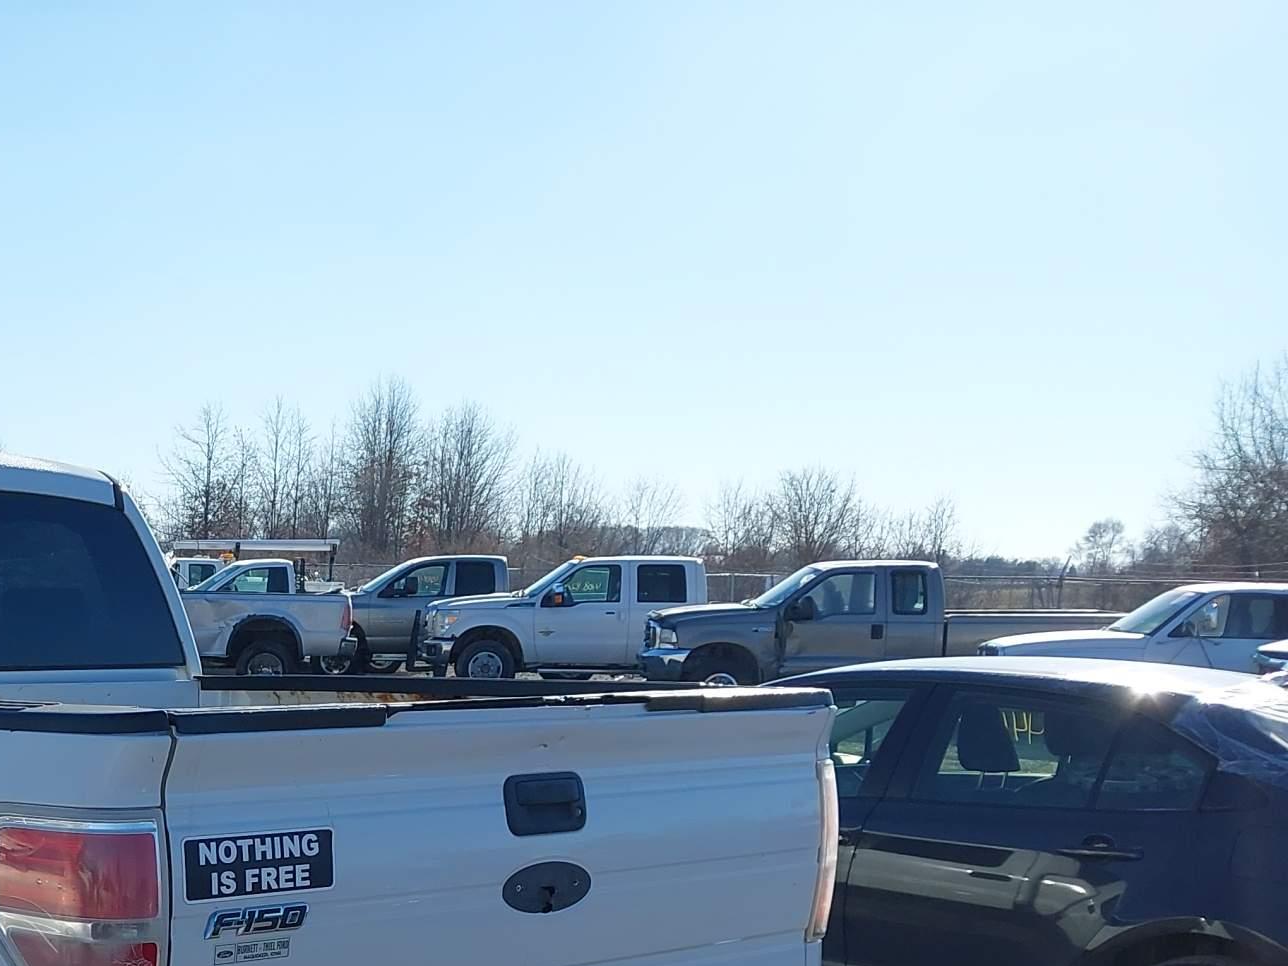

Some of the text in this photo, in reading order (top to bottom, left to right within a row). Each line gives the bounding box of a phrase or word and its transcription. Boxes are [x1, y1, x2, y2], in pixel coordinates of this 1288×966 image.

[198, 833, 320, 866] NOTHING
[211, 863, 311, 896] IS FREE
[204, 902, 309, 940] F-150
